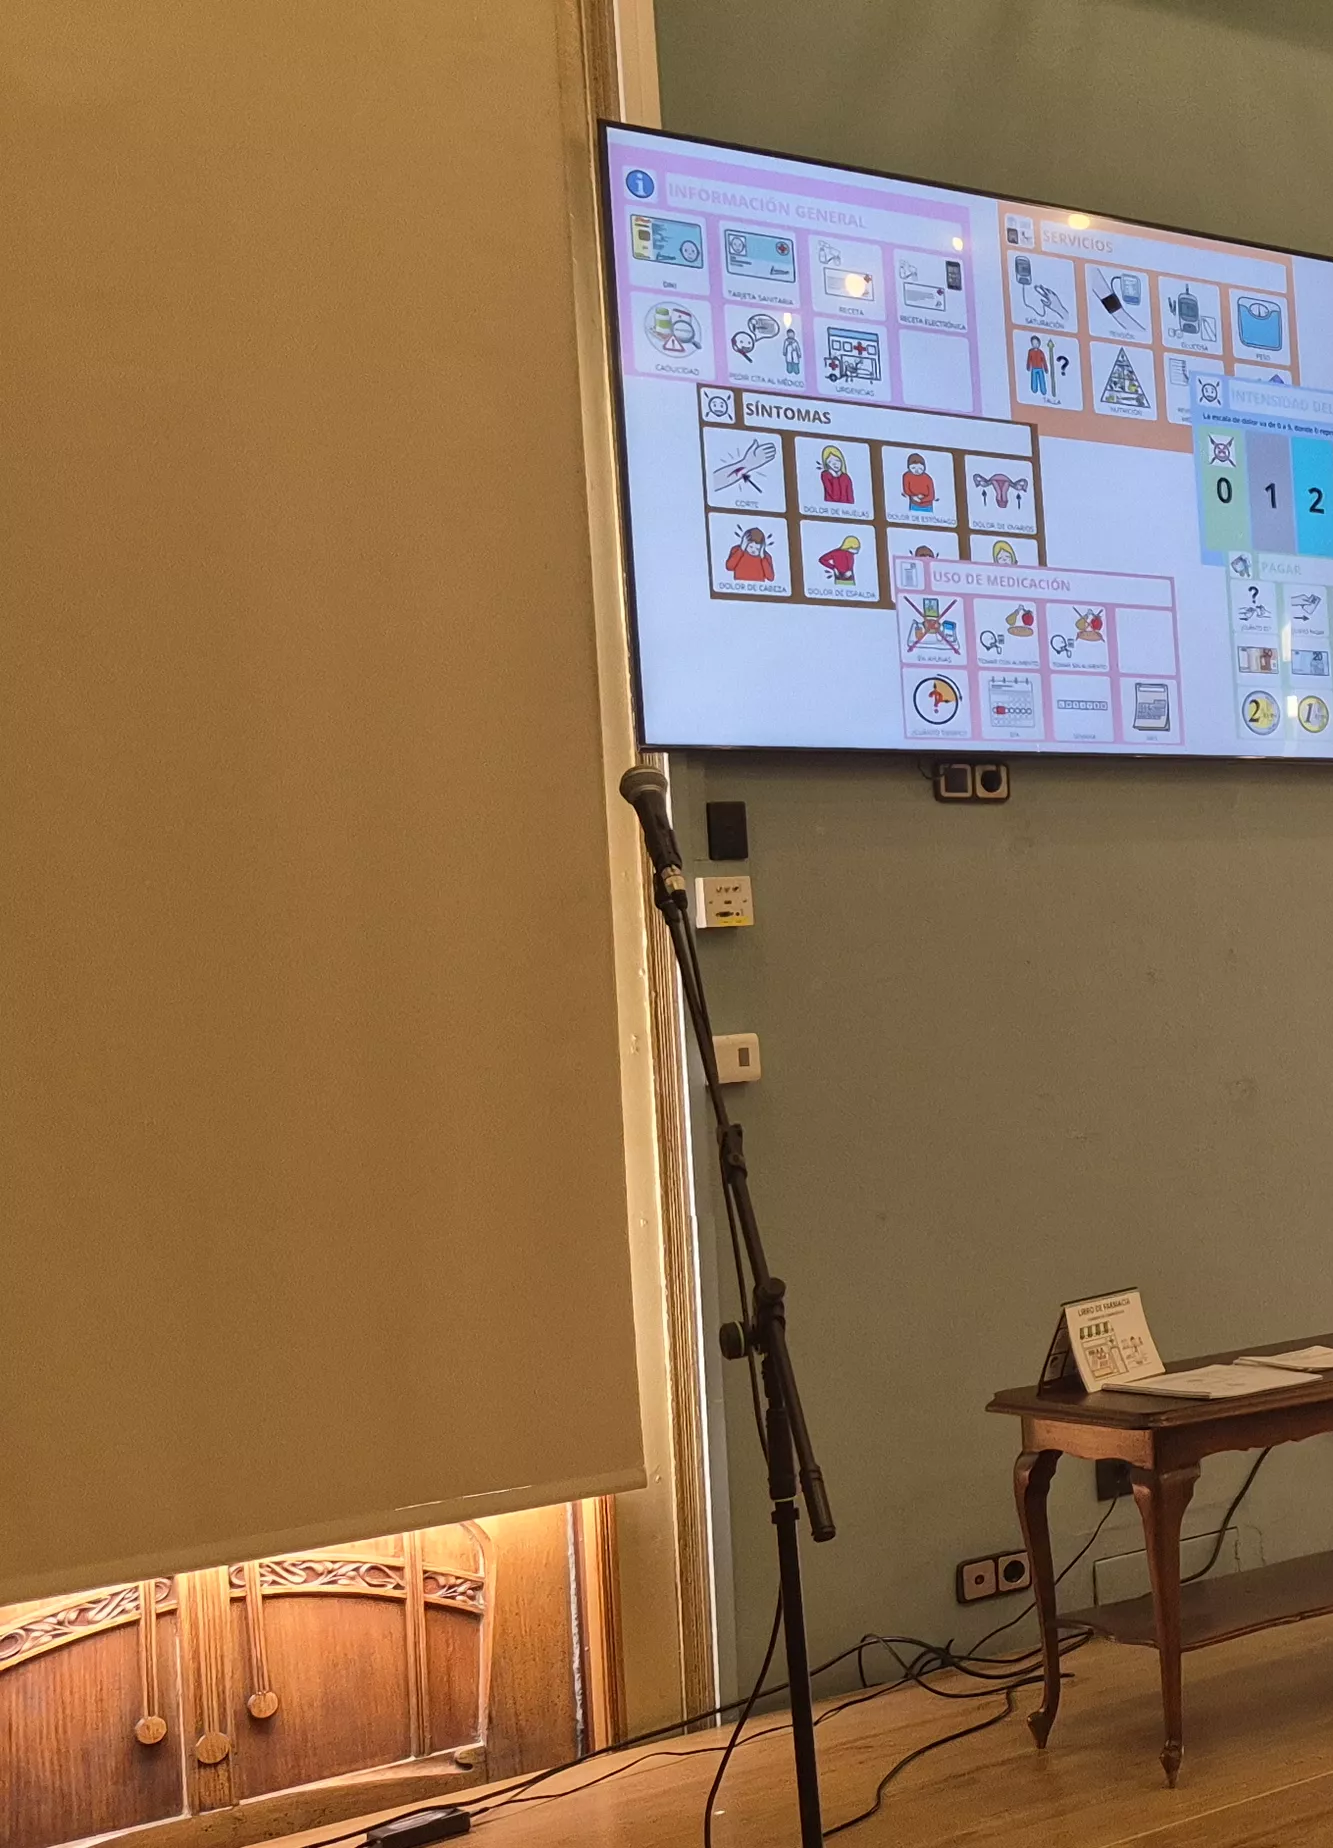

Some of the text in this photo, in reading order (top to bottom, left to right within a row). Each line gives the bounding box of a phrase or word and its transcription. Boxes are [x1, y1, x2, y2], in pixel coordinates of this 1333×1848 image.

[668, 183, 867, 228] INFORMACIÓN GENERAL
[1042, 229, 1114, 253] SERVICIOS
[839, 306, 864, 316] RECETA
[767, 377, 776, 385] AL
[745, 397, 832, 425] SÍNTOMAS
[1231, 389, 1309, 411] INTENSIDAD
[1216, 476, 1233, 504] 0
[1264, 482, 1277, 509] 1
[1307, 487, 1325, 514] 2
[803, 505, 830, 514] DOLOR
[831, 507, 840, 516] DE
[1261, 561, 1301, 576] PAGAR
[719, 581, 745, 591] DOLOR
[747, 583, 756, 592] DE
[808, 587, 833, 597] DOLOR
[835, 589, 844, 597] DE
[933, 570, 1071, 592] USO DE MEDICACIÓN
[1312, 651, 1323, 661] 20
[1248, 699, 1260, 723] 2
[1305, 703, 1313, 723] 1
